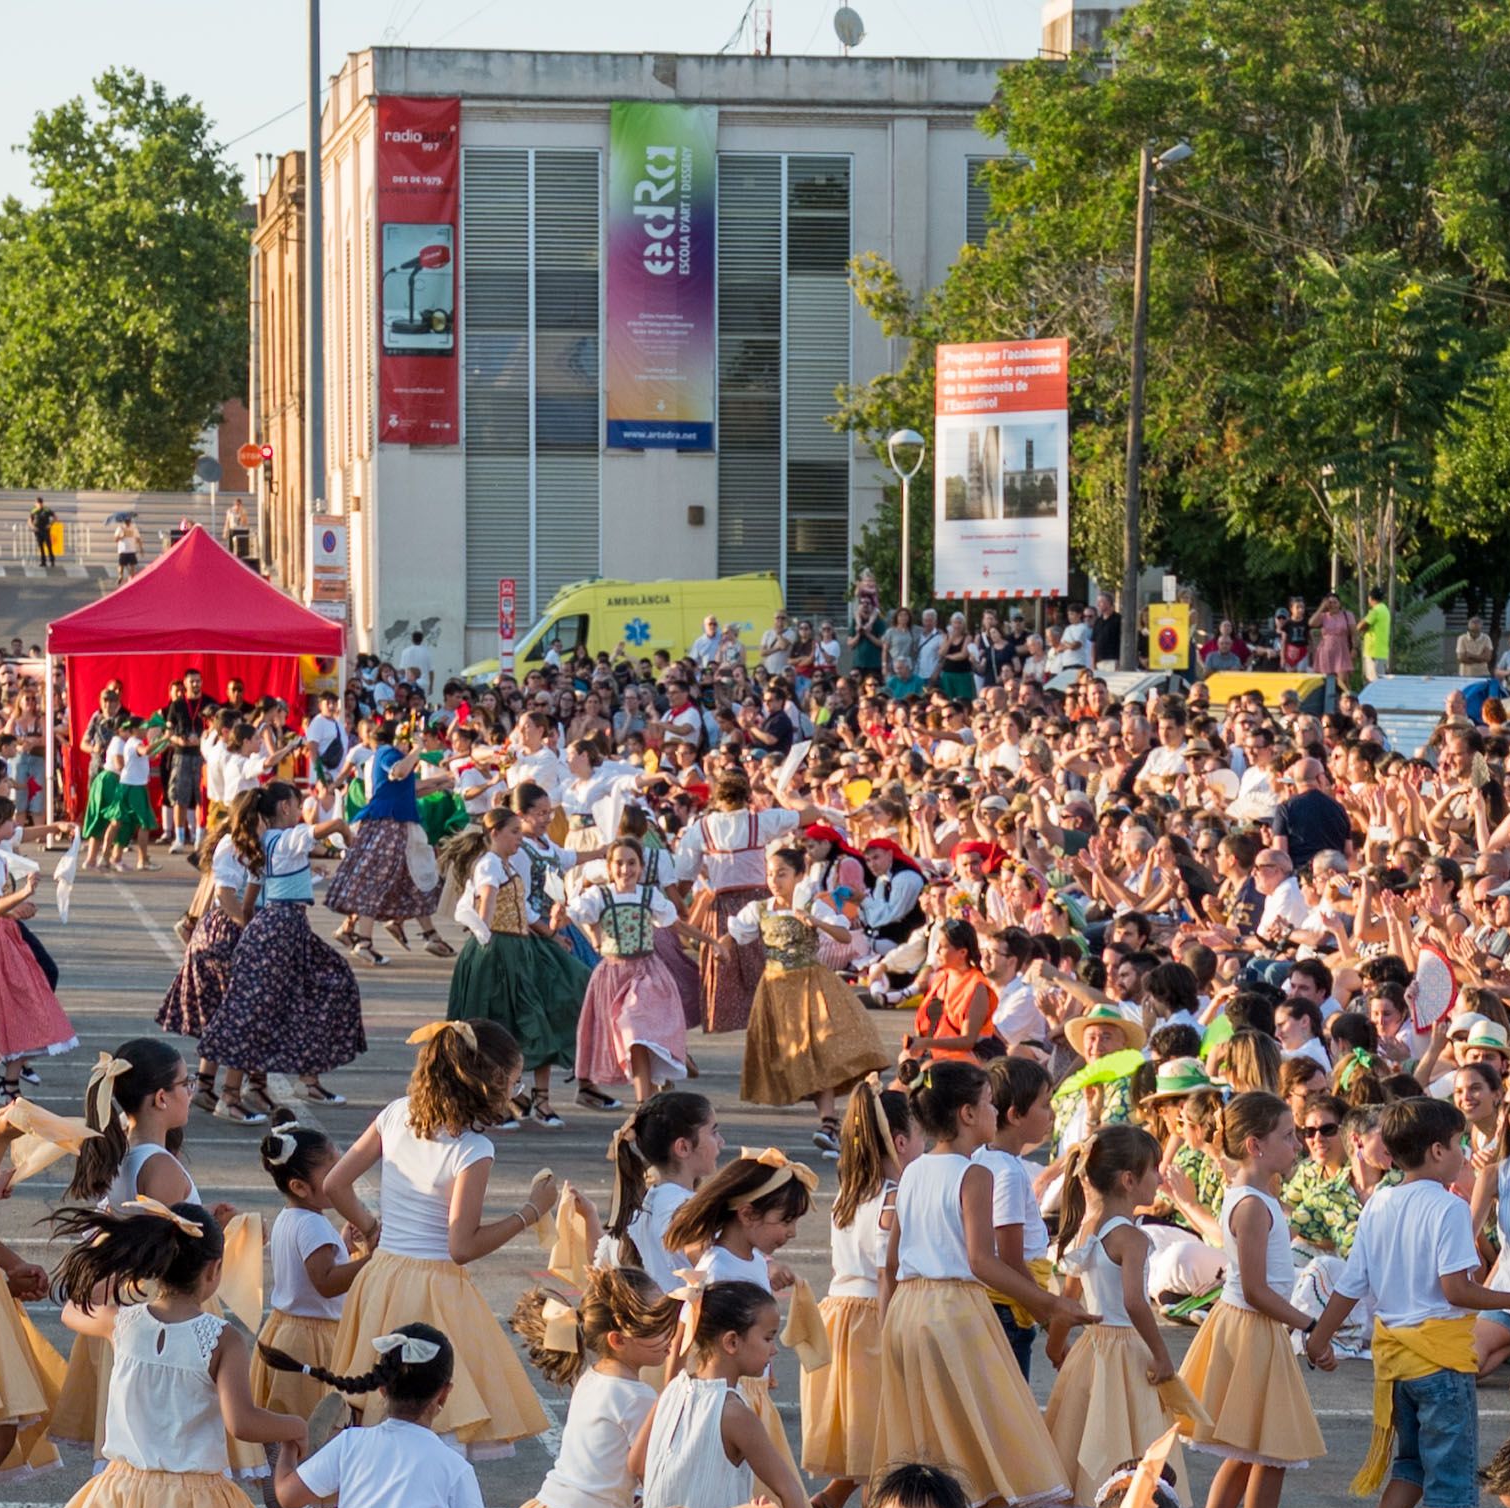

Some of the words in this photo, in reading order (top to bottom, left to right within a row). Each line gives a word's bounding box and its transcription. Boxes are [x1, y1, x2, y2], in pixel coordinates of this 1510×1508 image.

[680, 146, 692, 191] DISSENY
[392, 175, 408, 184] DES
[409, 175, 421, 184] DE
[679, 201, 691, 232] D'ART
[679, 235, 691, 275] ESCOLA
[944, 368, 956, 379] de
[1001, 365, 1013, 376] de
[944, 384, 956, 395] de
[1015, 380, 1028, 392] de
[623, 430, 697, 440] www.artedra.net
